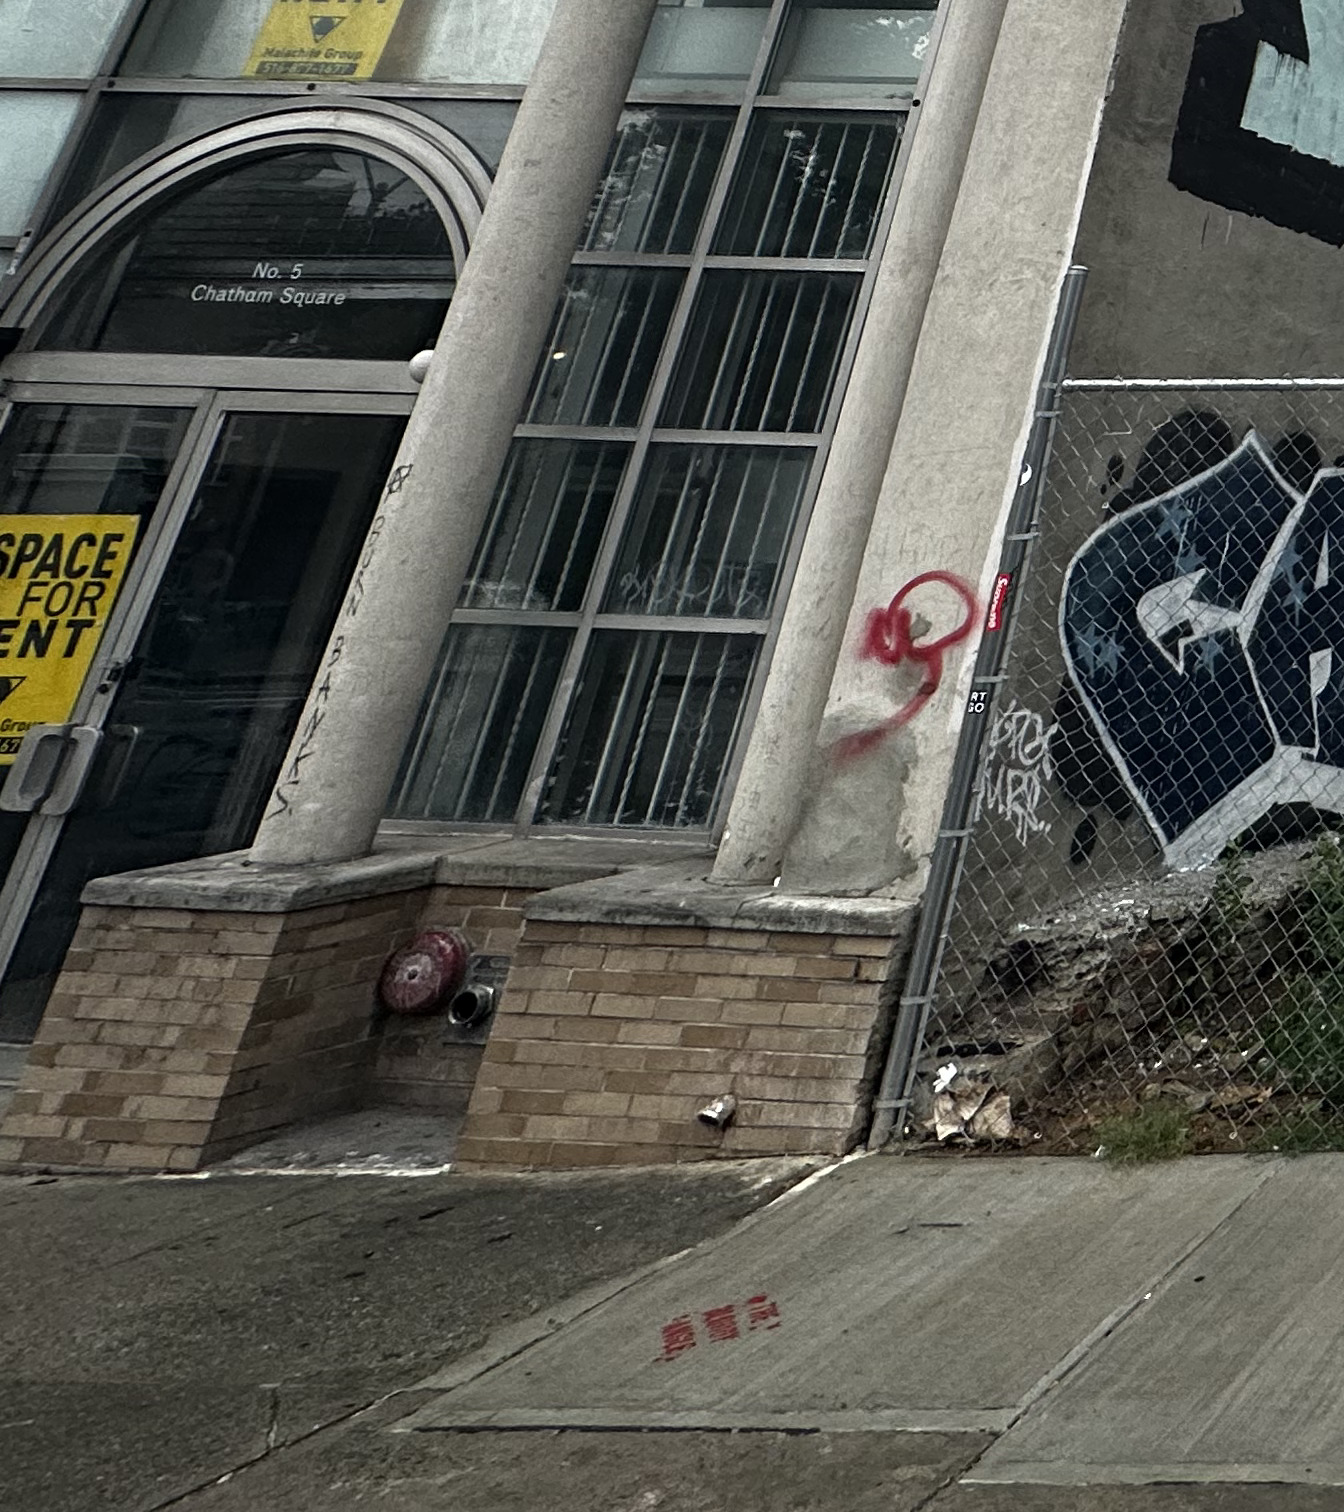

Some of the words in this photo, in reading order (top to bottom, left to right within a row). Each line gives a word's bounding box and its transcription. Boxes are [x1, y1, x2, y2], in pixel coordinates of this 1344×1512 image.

[324, 48, 363, 61] Group
[252, 262, 282, 279] No.
[289, 263, 303, 279] 5
[191, 285, 273, 303] Chatham
[279, 287, 346, 307] Square
[16, 580, 107, 617] FOR
